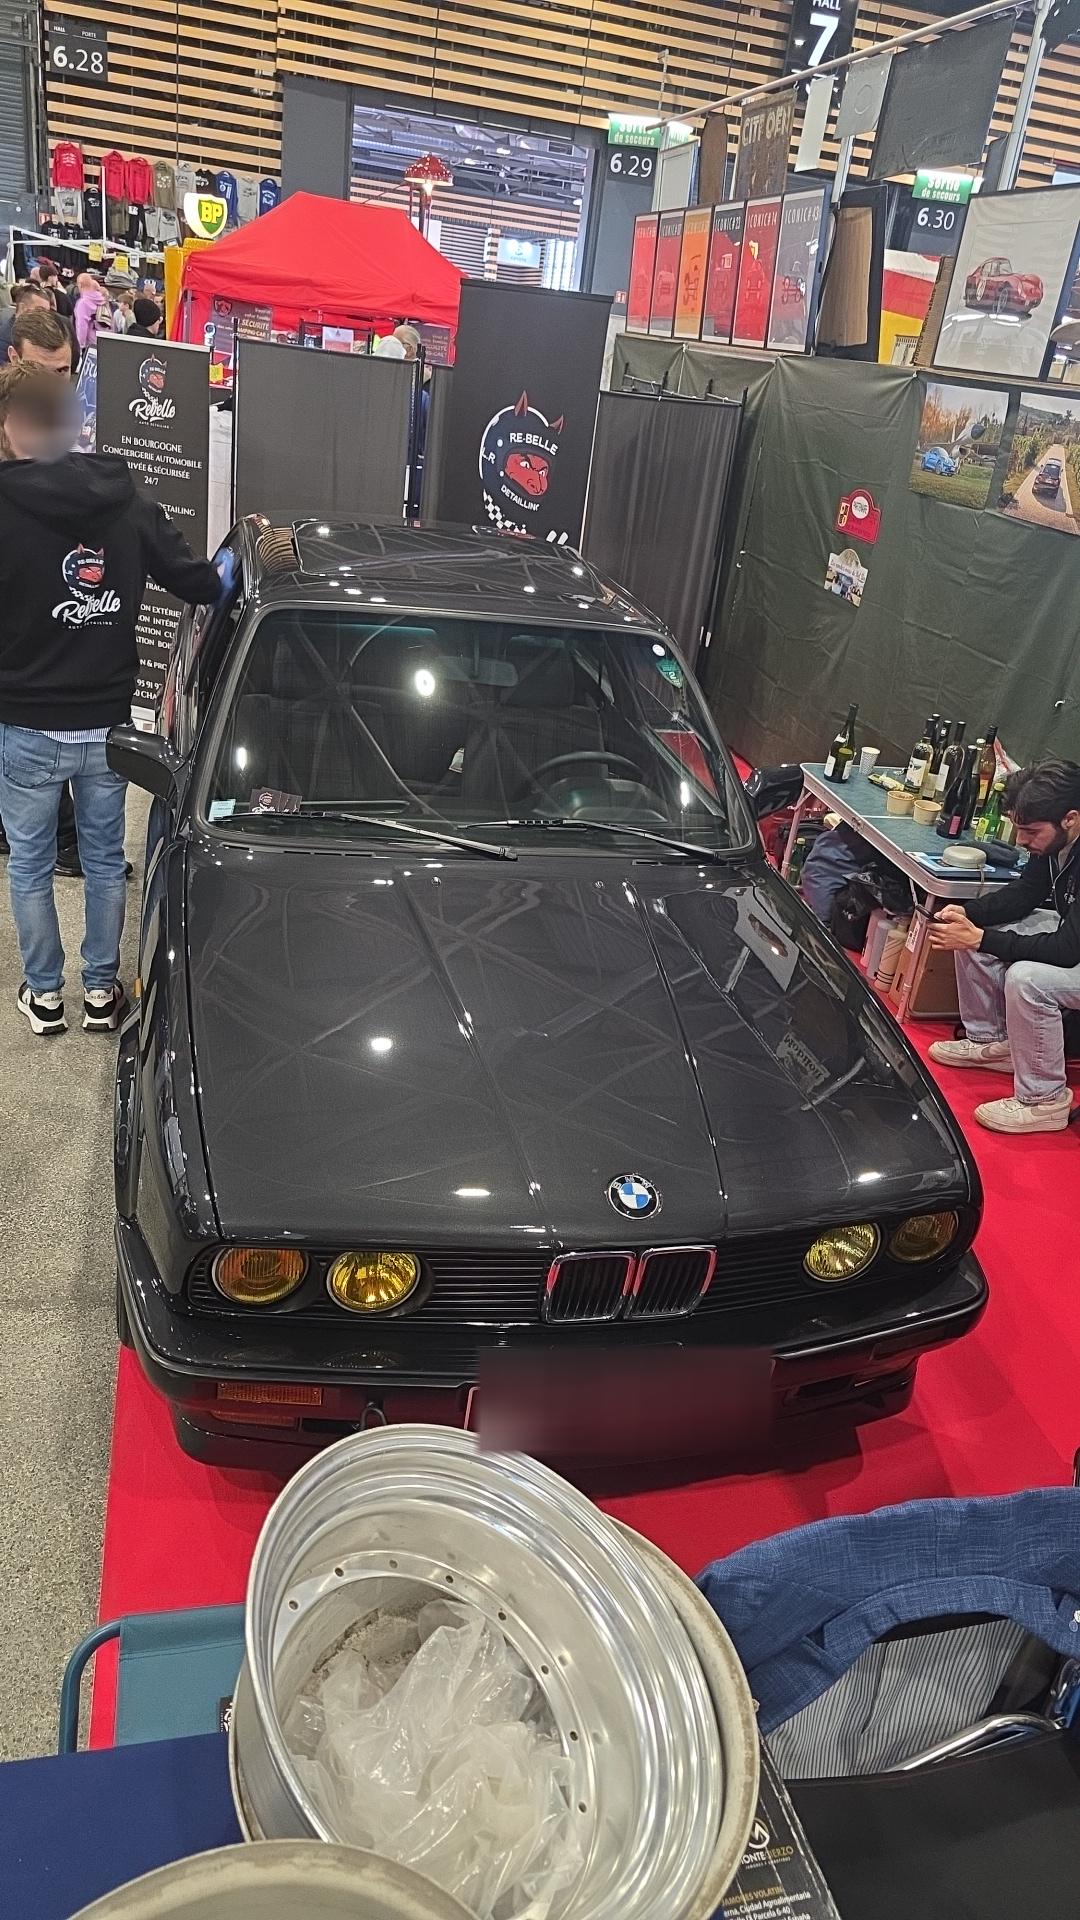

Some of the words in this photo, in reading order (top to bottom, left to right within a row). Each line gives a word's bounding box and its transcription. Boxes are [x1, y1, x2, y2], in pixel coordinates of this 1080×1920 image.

[81, 31, 97, 39] PORTE
[807, 12, 840, 67] 7
[53, 45, 104, 74] 6.28
[614, 132, 623, 143] de
[624, 134, 655, 146] secours
[610, 153, 652, 178] 6.29
[921, 187, 931, 198] de
[931, 191, 961, 202] secours
[200, 201, 223, 224] BP
[917, 207, 955, 231] 6.30
[121, 435, 132, 445] EN
[133, 437, 183, 453] BOURGOGNE
[509, 432, 559, 456] RE-BELLE
[126, 460, 146, 471] RIVÉE
[147, 463, 153, 473] &
[153, 465, 190, 479] SÉCURISÉE
[155, 455, 203, 469] AUTOMOBILE
[144, 475, 159, 485] 24/7
[159, 502, 195, 517] ETAILING
[153, 617, 177, 628] INTÉRI
[146, 660, 153, 668] &
[611, 1176, 653, 1190] BMW
